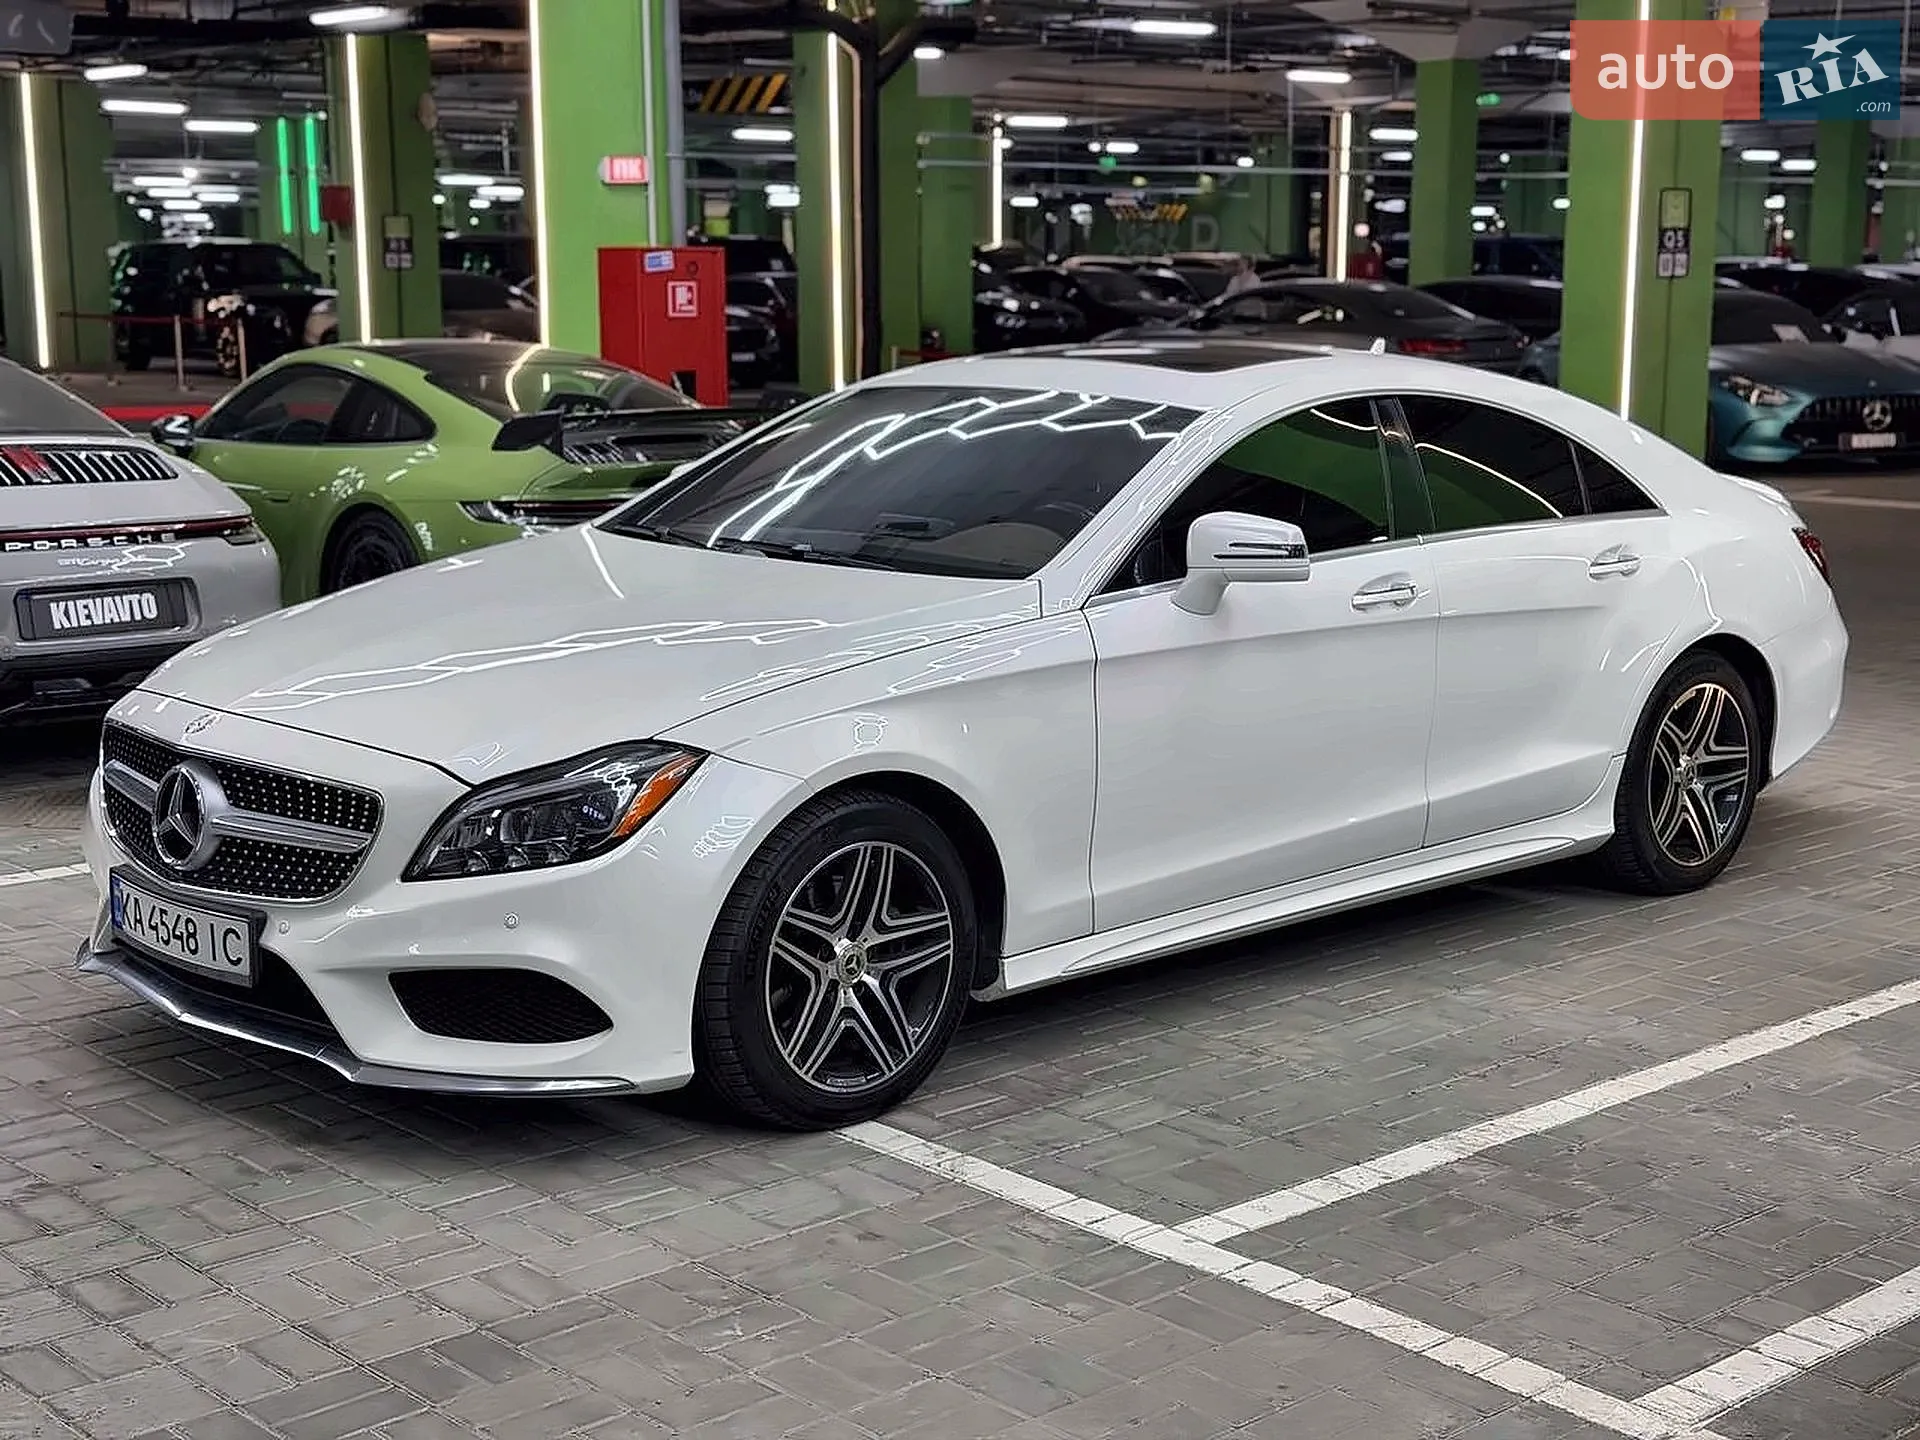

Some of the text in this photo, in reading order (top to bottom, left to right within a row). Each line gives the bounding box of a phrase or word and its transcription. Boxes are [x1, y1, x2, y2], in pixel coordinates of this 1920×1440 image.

[5, 533, 176, 551] PORSCHE
[50, 593, 158, 629] KIEVAVTO
[121, 889, 145, 936] KA
[148, 905, 199, 956] 4548
